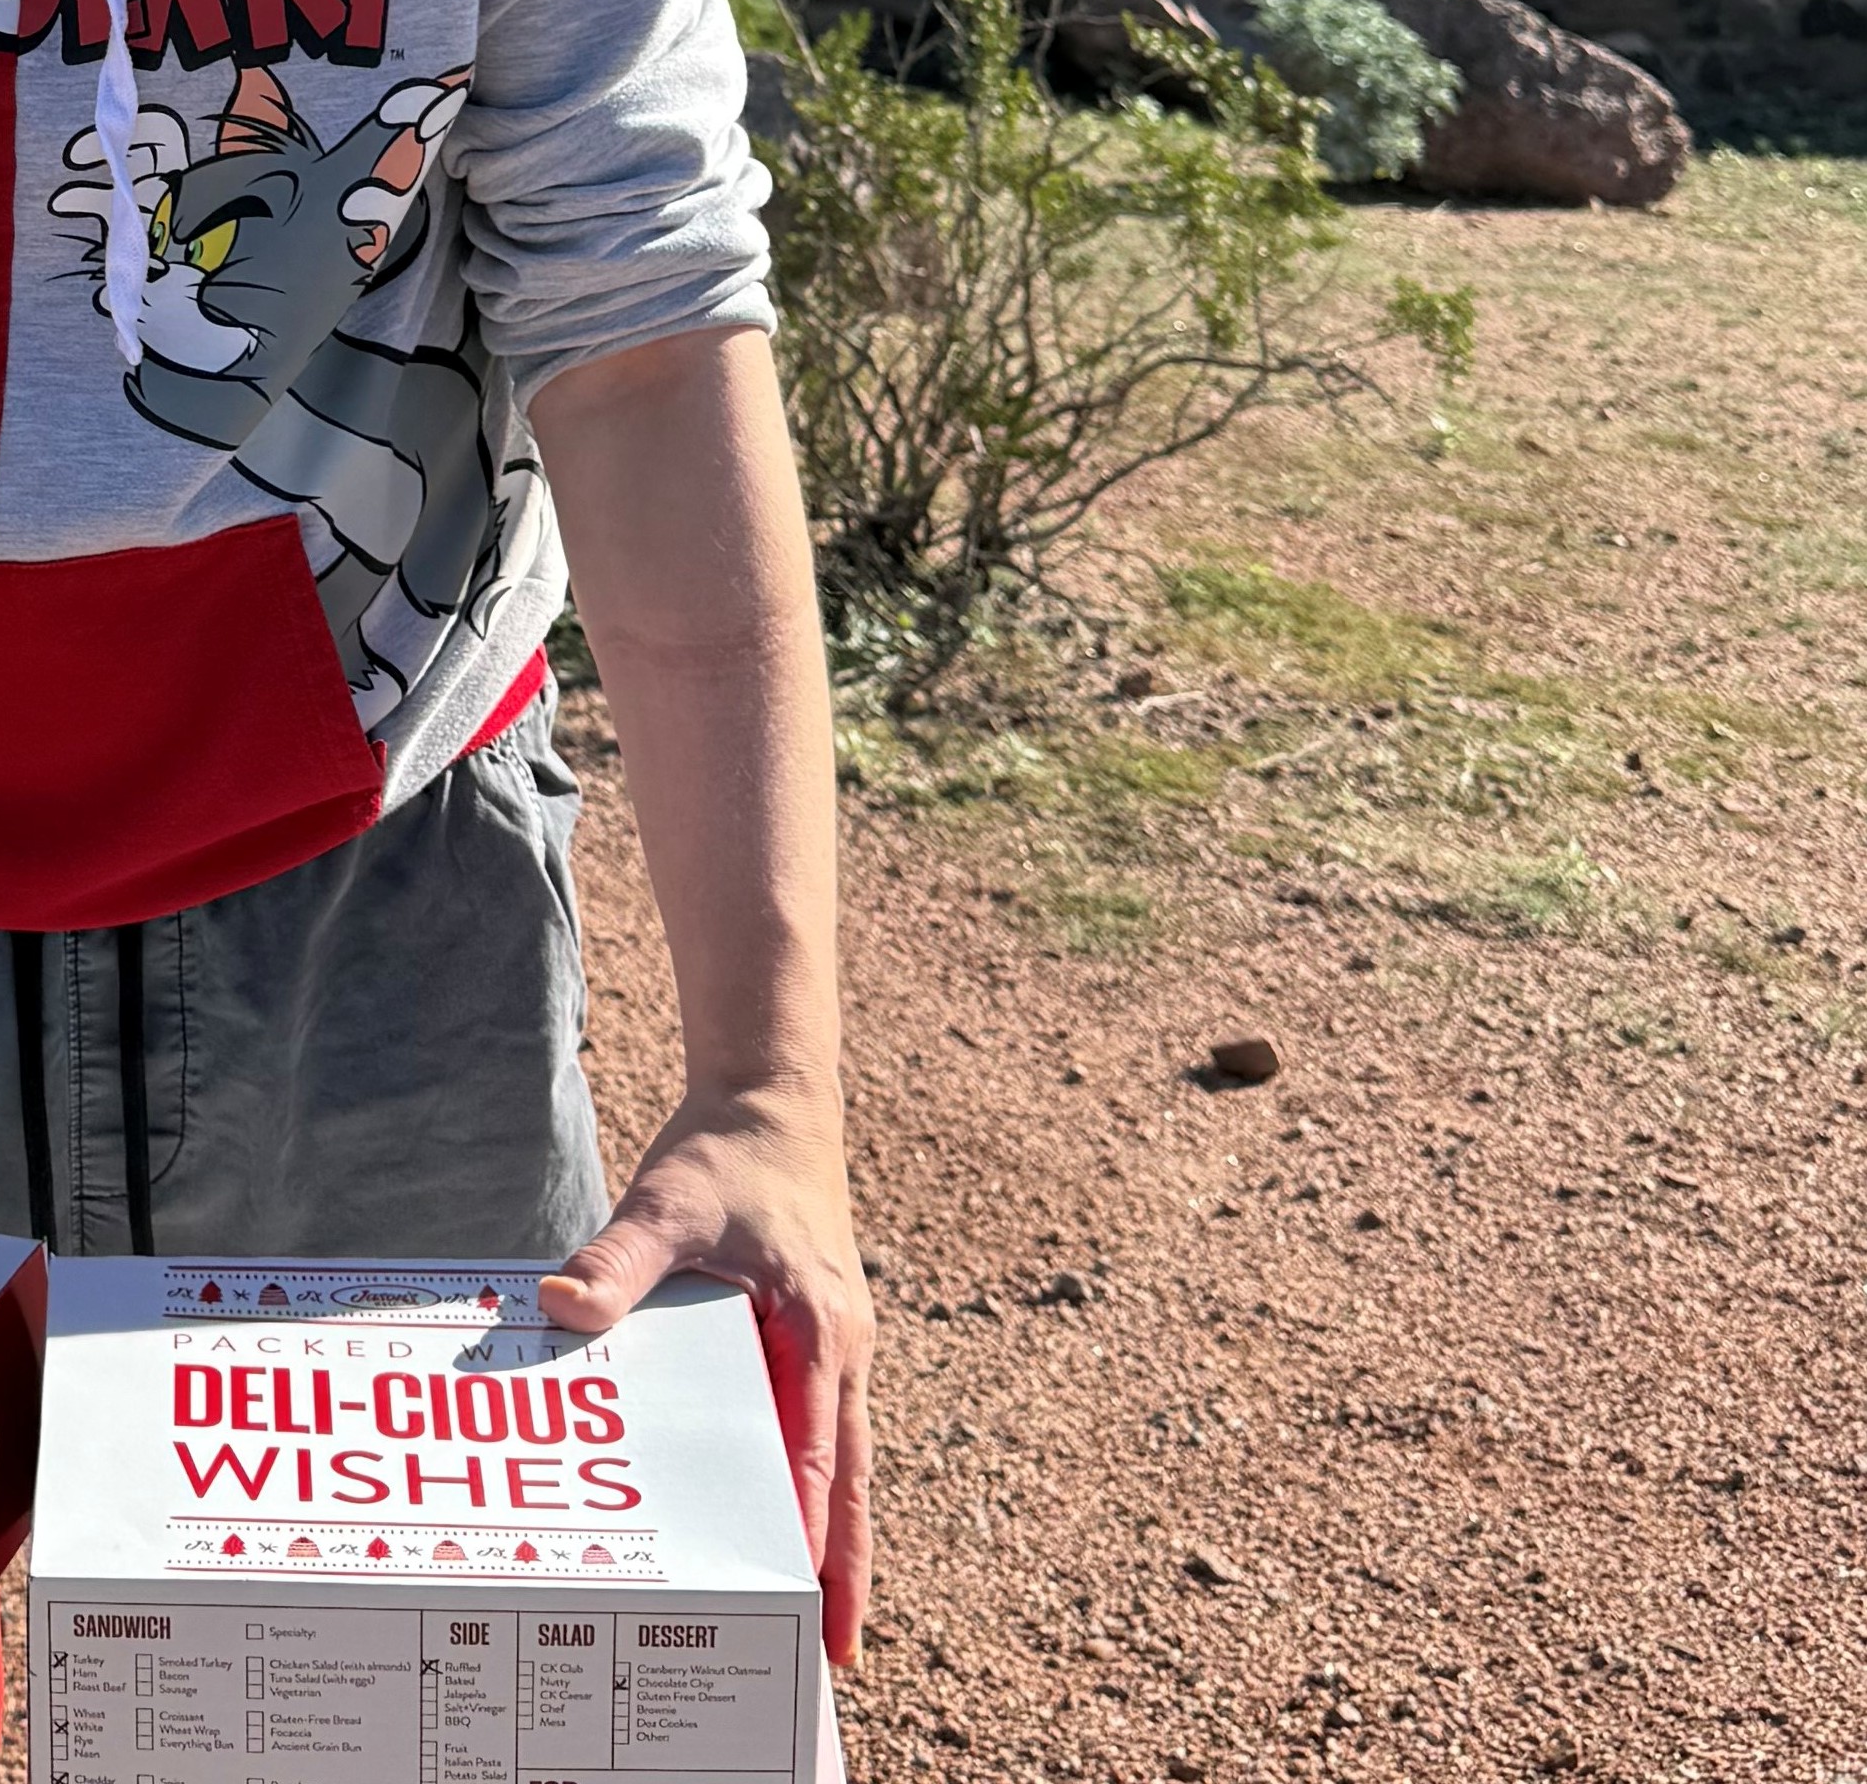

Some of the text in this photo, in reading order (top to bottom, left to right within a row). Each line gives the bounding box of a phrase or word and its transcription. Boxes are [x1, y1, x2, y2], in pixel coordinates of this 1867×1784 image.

[390, 48, 404, 61] TM
[173, 1334, 611, 1363] PACKED WITH
[173, 1363, 626, 1445] DELI-CIOUS
[173, 1441, 642, 1511] WISHES
[73, 1614, 171, 1640] SANDWICH
[450, 1622, 490, 1645] SIDE
[538, 1623, 595, 1647] SALAD
[638, 1624, 719, 1648] DESSERT
[73, 1654, 105, 1668] Turkey
[158, 1656, 233, 1672] Smoked Turkey
[269, 1659, 412, 1673] Chicken Salad (with almonds)
[73, 1668, 97, 1678] Ham
[445, 1662, 481, 1673] Ruffled
[540, 1663, 584, 1674] CK Club
[637, 1664, 772, 1677] Cranberry Walnut Oatmeal
[159, 1670, 189, 1681] Bacon
[269, 1673, 293, 1683] Tuna
[295, 1673, 321, 1684] Salad
[322, 1673, 348, 1685] (with
[445, 1676, 475, 1686] Baked
[73, 1682, 127, 1693] Roast Beef
[540, 1676, 571, 1689] Nutty
[637, 1677, 715, 1692] Chocolate Chip
[159, 1684, 198, 1698] Sausage
[269, 1687, 322, 1700] Vegetarian
[540, 1690, 557, 1701] CK
[637, 1691, 736, 1703] Gluten Free Dessert
[73, 1708, 105, 1719] Wheat
[540, 1703, 565, 1714] Chef
[637, 1704, 677, 1715] Brownie
[333, 1715, 362, 1725] Bread
[445, 1716, 471, 1729] BBQ
[539, 1717, 566, 1727] Mesa
[659, 1718, 698, 1729] Cookies
[73, 1721, 103, 1733] White
[159, 1725, 221, 1738] Wheat Wrap
[270, 1728, 312, 1738] Focaccia
[74, 1735, 93, 1748] Rye
[160, 1738, 234, 1752] Everything Bun
[271, 1741, 362, 1752] Ancient Grain Bun
[445, 1743, 468, 1754] Fruit
[444, 1757, 502, 1768] Italian Pasta
[444, 1770, 507, 1781] Potato Salad
